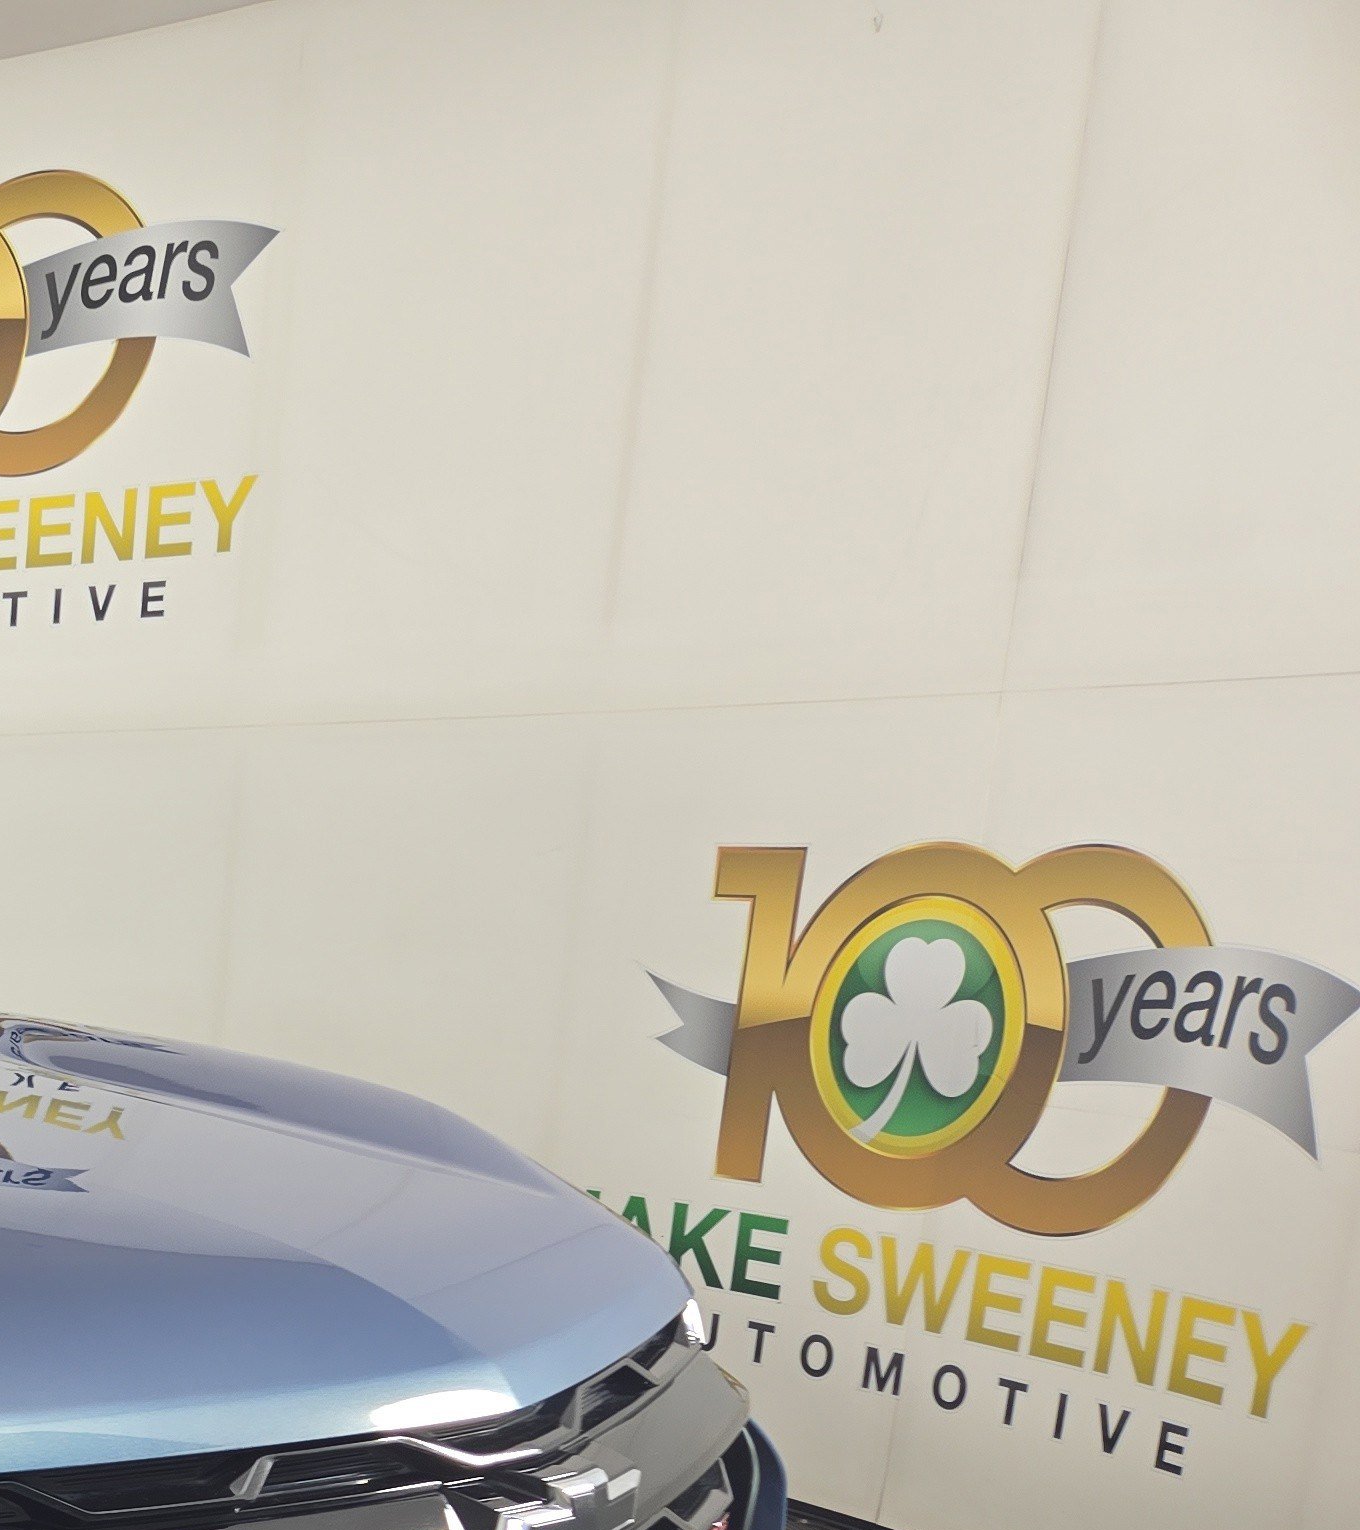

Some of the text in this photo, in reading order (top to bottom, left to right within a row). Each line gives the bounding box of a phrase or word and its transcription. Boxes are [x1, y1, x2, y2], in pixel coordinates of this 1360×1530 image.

[40, 236, 220, 340] years
[712, 842, 1297, 1238] 100 years
[813, 1227, 1310, 1420] SWEENEY
